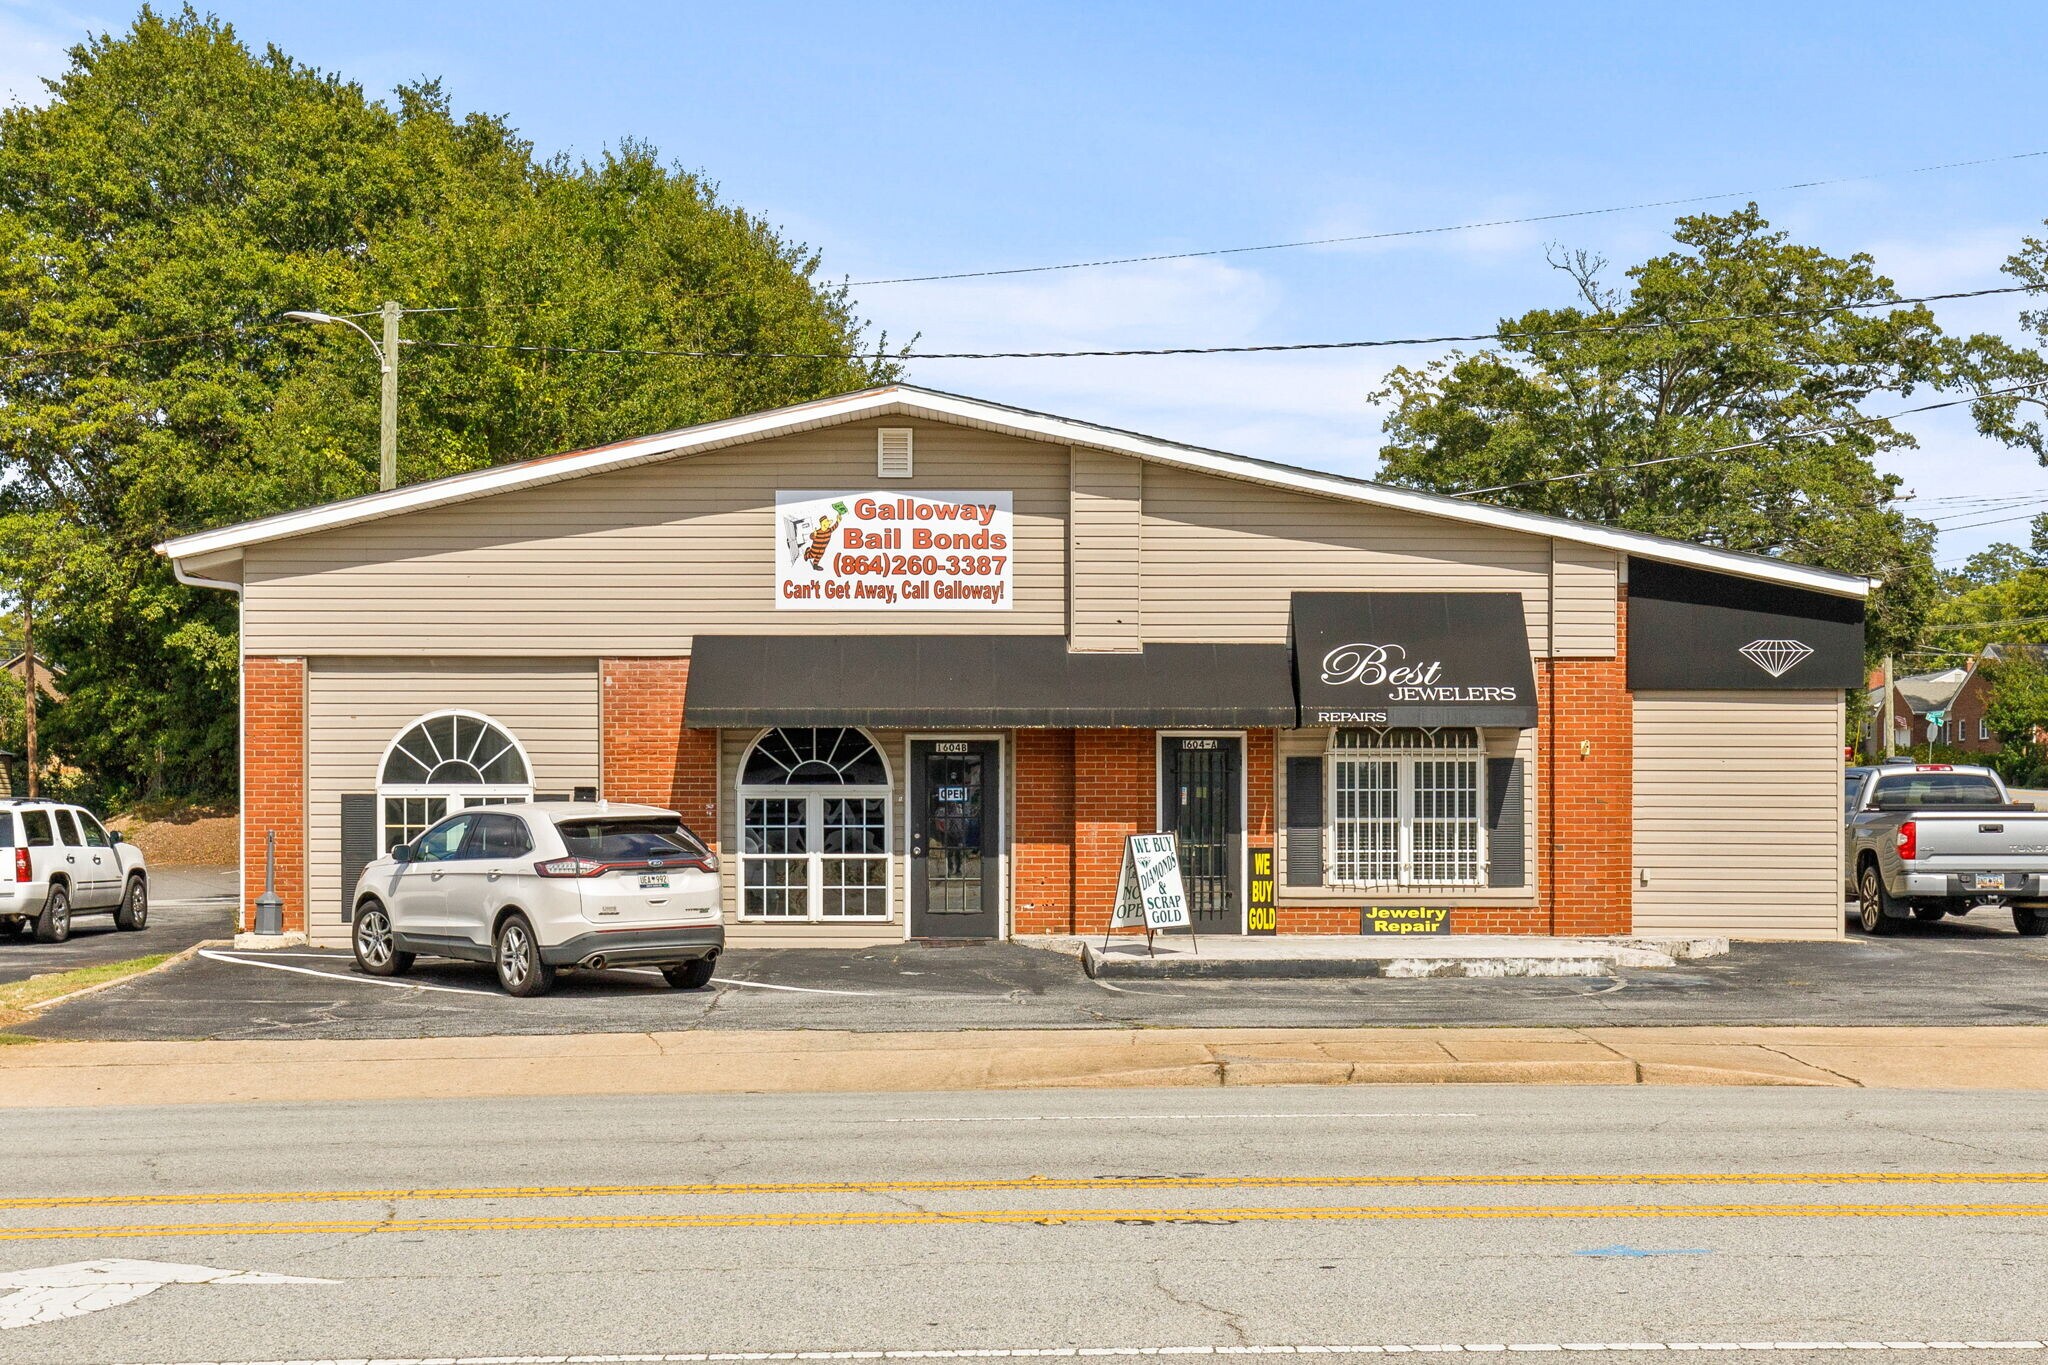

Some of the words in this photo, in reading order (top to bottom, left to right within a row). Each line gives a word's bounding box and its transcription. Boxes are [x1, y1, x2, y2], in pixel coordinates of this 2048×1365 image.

[854, 498, 996, 526] Galloway
[843, 528, 901, 549] Bail
[912, 528, 1007, 550] Bonds
[833, 553, 1007, 578] (864)260-3387
[783, 579, 821, 599] Can't
[824, 579, 851, 599] Get
[854, 580, 898, 604] Away,
[901, 579, 930, 600] Call
[933, 579, 1005, 604] Galloway!
[1321, 643, 1442, 686] Best
[1388, 686, 1517, 701] JEWELERS
[1318, 712, 1387, 722] REPAIRS
[1133, 838, 1152, 854] WE
[1152, 836, 1173, 853] BUY
[1141, 852, 1177, 891] DIAMONDS
[1254, 853, 1270, 875] WE
[1158, 881, 1167, 895] &
[1252, 881, 1274, 903] BUY
[1116, 903, 1144, 919] OPE
[1147, 895, 1181, 910] SCRAP
[1152, 909, 1182, 923] GOLD
[1249, 908, 1276, 930] GOLD
[1366, 907, 1447, 921] Jewelry
[1374, 920, 1440, 934] Repair
